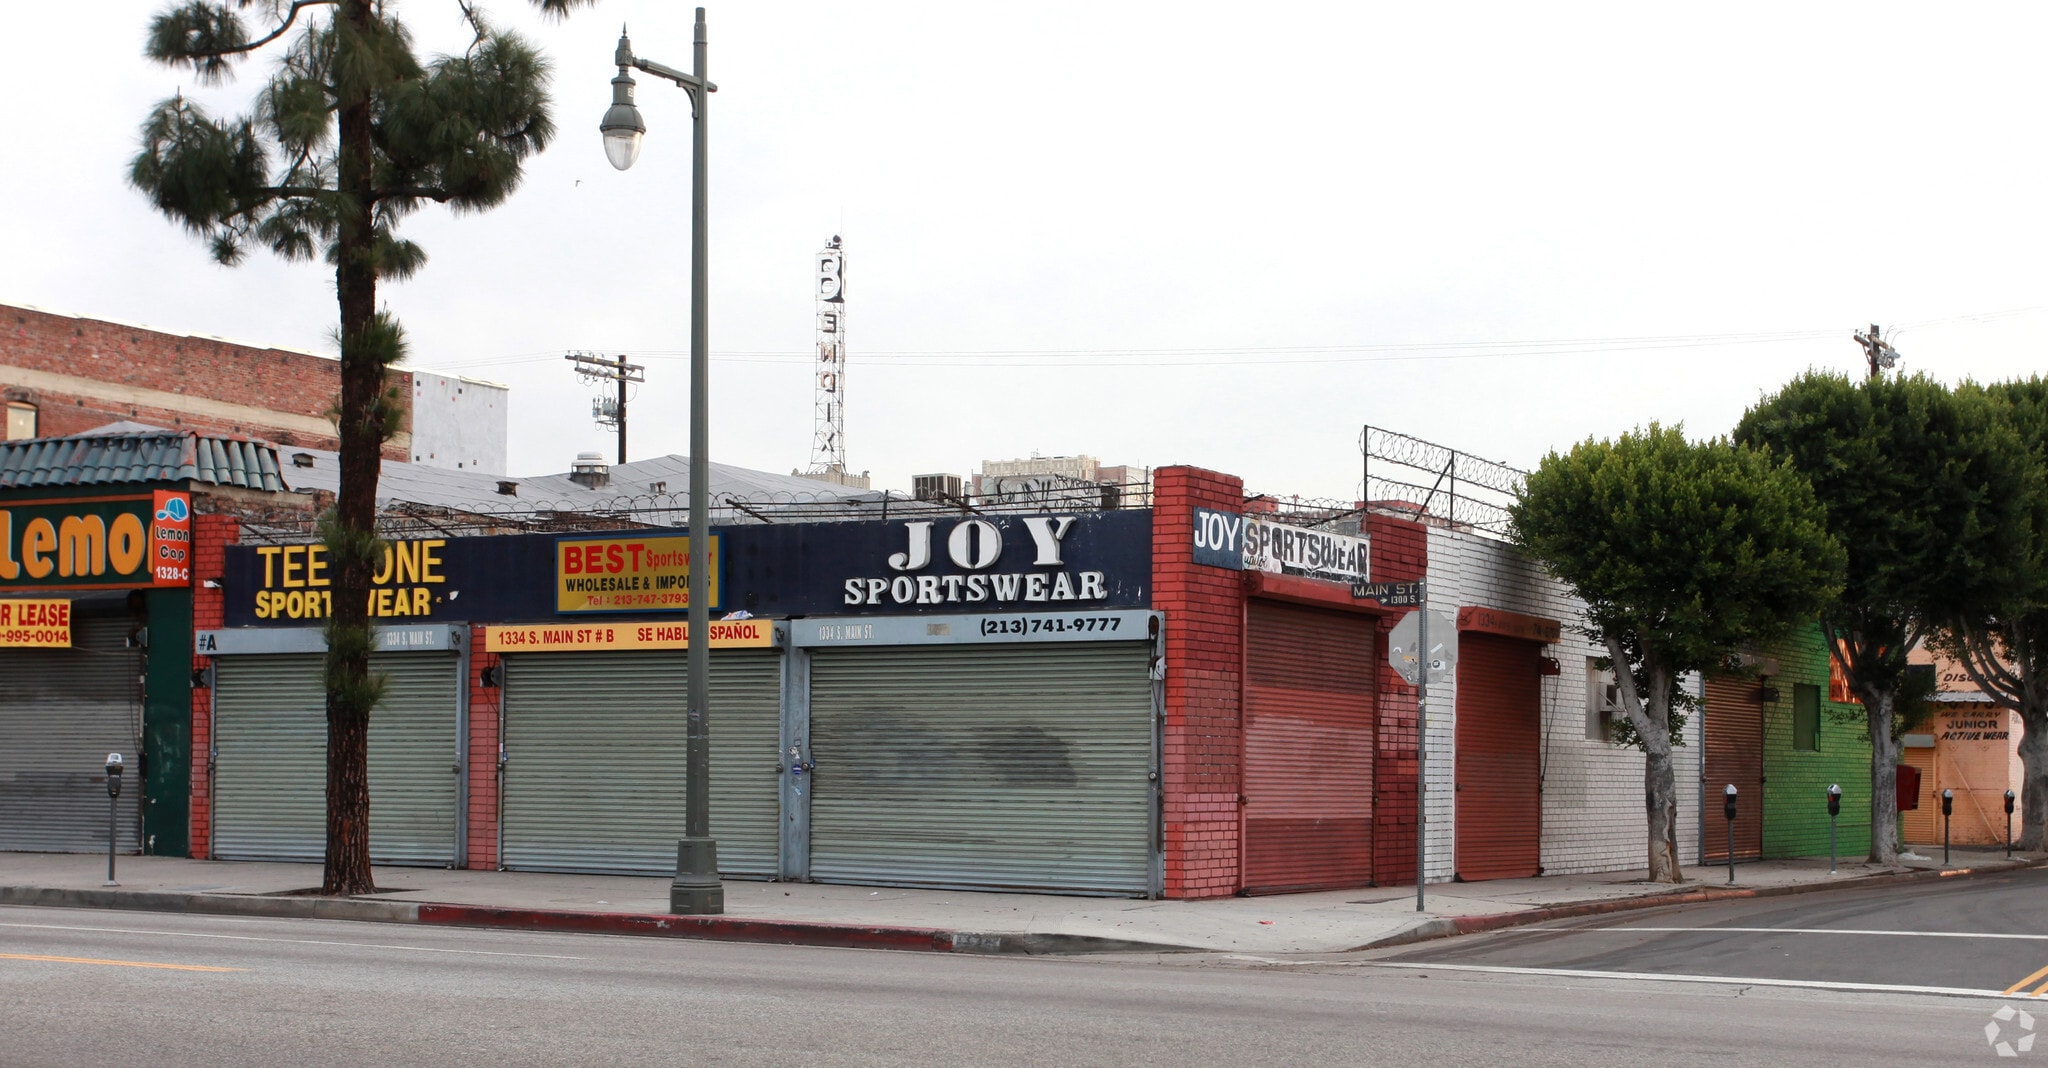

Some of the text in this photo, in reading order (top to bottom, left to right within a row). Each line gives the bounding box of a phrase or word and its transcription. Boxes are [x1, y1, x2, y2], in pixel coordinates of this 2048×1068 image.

[1195, 511, 1241, 552] JOY
[888, 516, 1077, 571] JOY
[1244, 521, 1368, 577] SPORTSWEAR
[159, 545, 185, 563] Cap
[256, 539, 446, 588] TEE ONE
[564, 543, 713, 574] BEST Sportsr
[156, 566, 188, 580] 1328-C
[565, 575, 711, 593] WHOLESALE & IMPO
[844, 572, 1108, 605] SPORTSWEAR
[1354, 583, 1418, 597] MAIN ST.
[587, 594, 602, 607] Tel
[614, 593, 689, 606] 213-747-3793
[1391, 596, 1408, 605] 1300
[18, 604, 69, 626] LEASE
[498, 631, 525, 646] 1334
[528, 630, 539, 645] S.
[543, 629, 573, 645] MAIN
[577, 629, 591, 643] ST
[606, 628, 614, 642] B
[637, 627, 653, 642] SE
[656, 626, 689, 641] HABL
[709, 622, 760, 640] SPAÑOL
[1946, 720, 1998, 729] JUNIOR
[1939, 731, 2009, 741] ACTIVE WEAR
